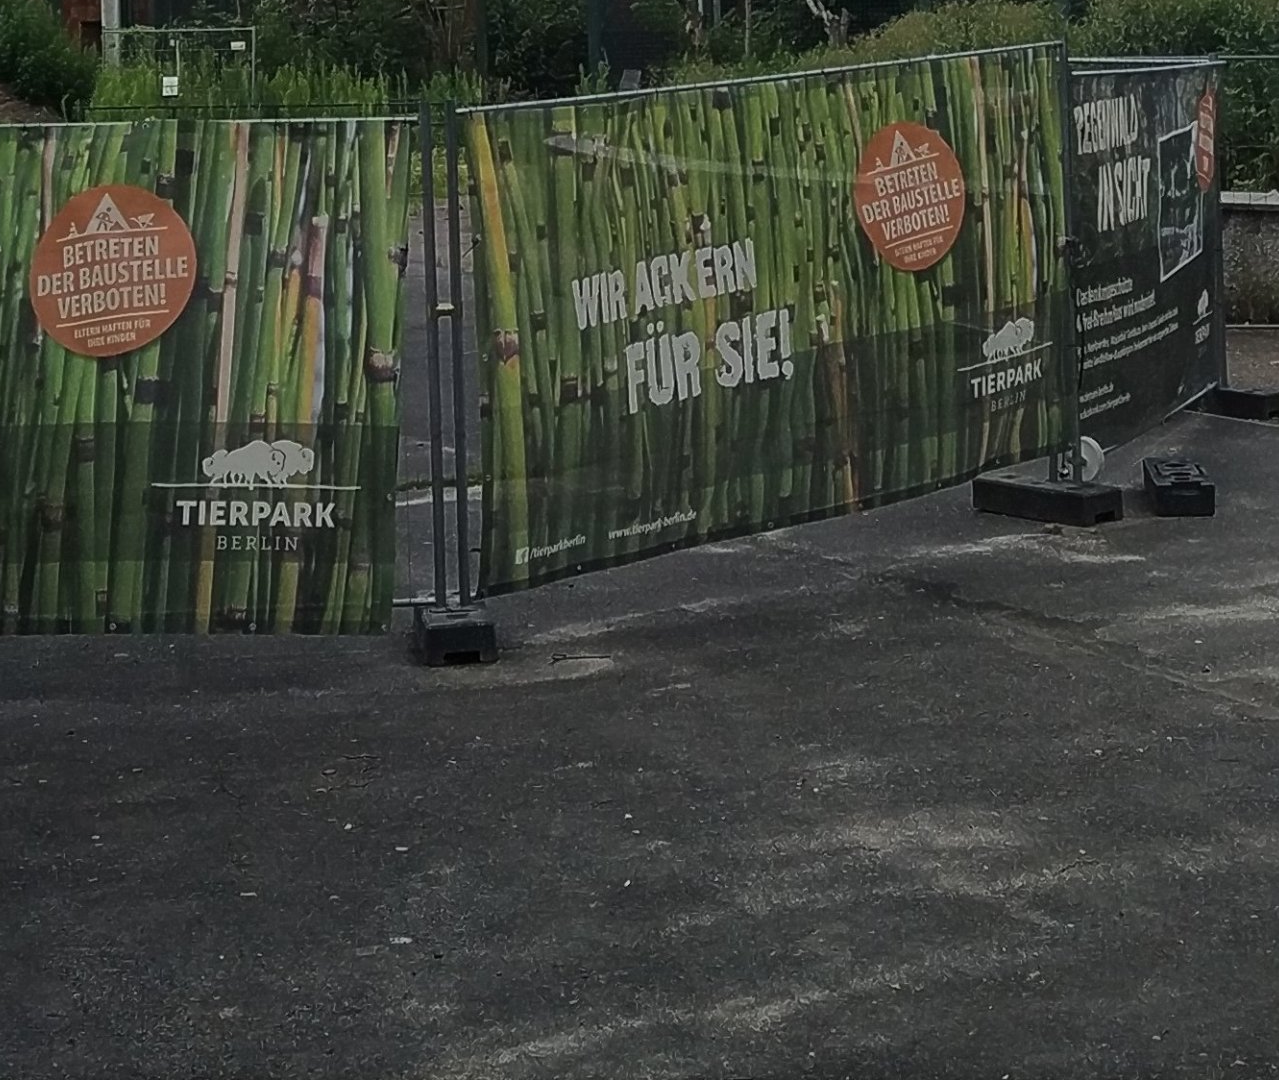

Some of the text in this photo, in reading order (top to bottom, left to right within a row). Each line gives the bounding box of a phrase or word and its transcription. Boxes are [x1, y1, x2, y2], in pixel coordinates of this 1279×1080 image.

[875, 161, 939, 196] BETRETEN
[1115, 155, 1151, 226] SICHT
[861, 178, 961, 225] DER BAUSTELLE
[881, 204, 950, 240] VERBOTEN!
[63, 235, 159, 269] BETRETEN
[37, 255, 189, 298] DER BAUSTELLE
[572, 238, 757, 331] WIR ACKERN
[57, 283, 167, 320] VERBOTEN!
[625, 309, 794, 414] FÜR SIE!
[971, 358, 1042, 398] TIERPARK
[991, 390, 1026, 412] BERLIN
[176, 499, 335, 529] TIERPARK
[217, 535, 299, 552] BERLIN
